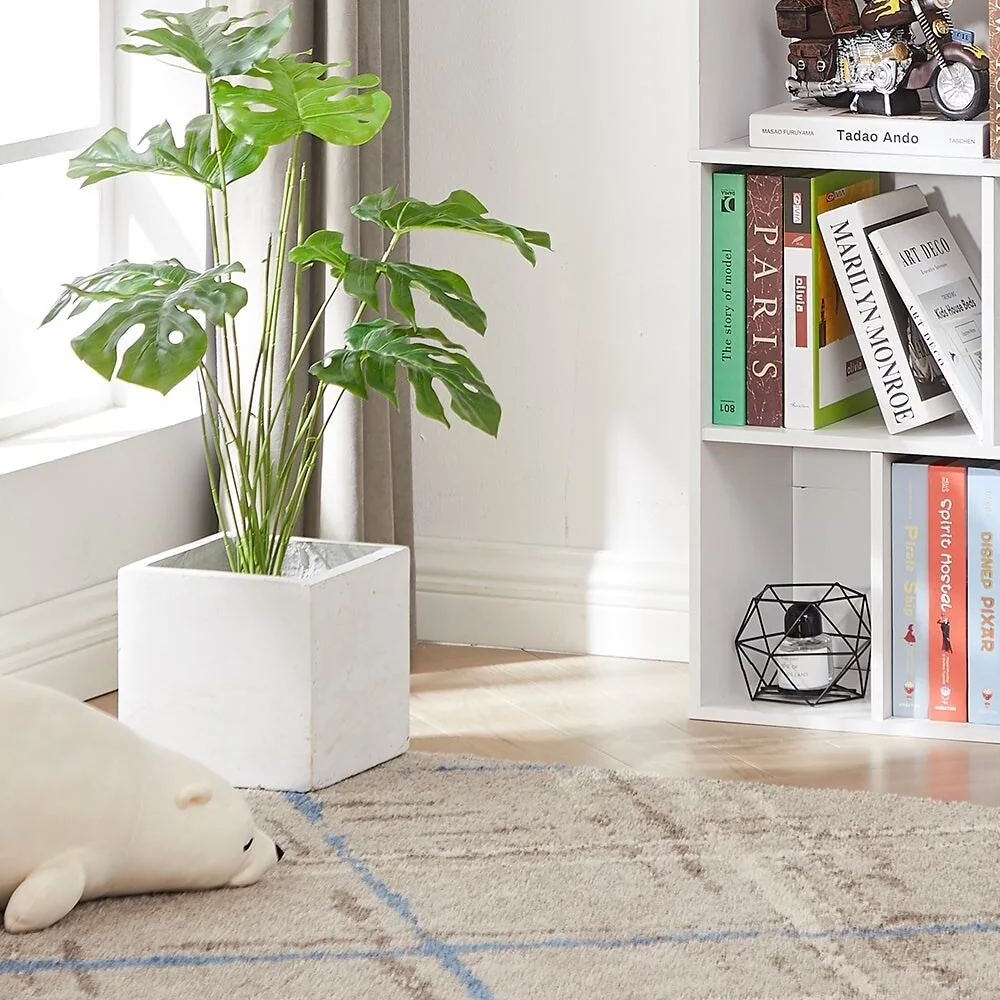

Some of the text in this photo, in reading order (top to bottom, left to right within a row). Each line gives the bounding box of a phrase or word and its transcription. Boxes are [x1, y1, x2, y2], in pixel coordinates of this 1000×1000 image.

[761, 128, 815, 137] MASAO FURUYAMA
[836, 129, 919, 145] Tadao Ando
[948, 137, 976, 145] TASCHEN
[898, 246, 921, 268] ART
[920, 237, 951, 260] DECO
[721, 249, 736, 362] The story of model
[752, 223, 779, 378] PARIS
[795, 277, 806, 313] olivia
[933, 305, 949, 320] Kids
[830, 219, 881, 324] MARILYN
[866, 326, 915, 424] MONROE
[939, 498, 953, 549] Spirit
[903, 581, 918, 617] Ship
[980, 596, 996, 652] PIXAR
